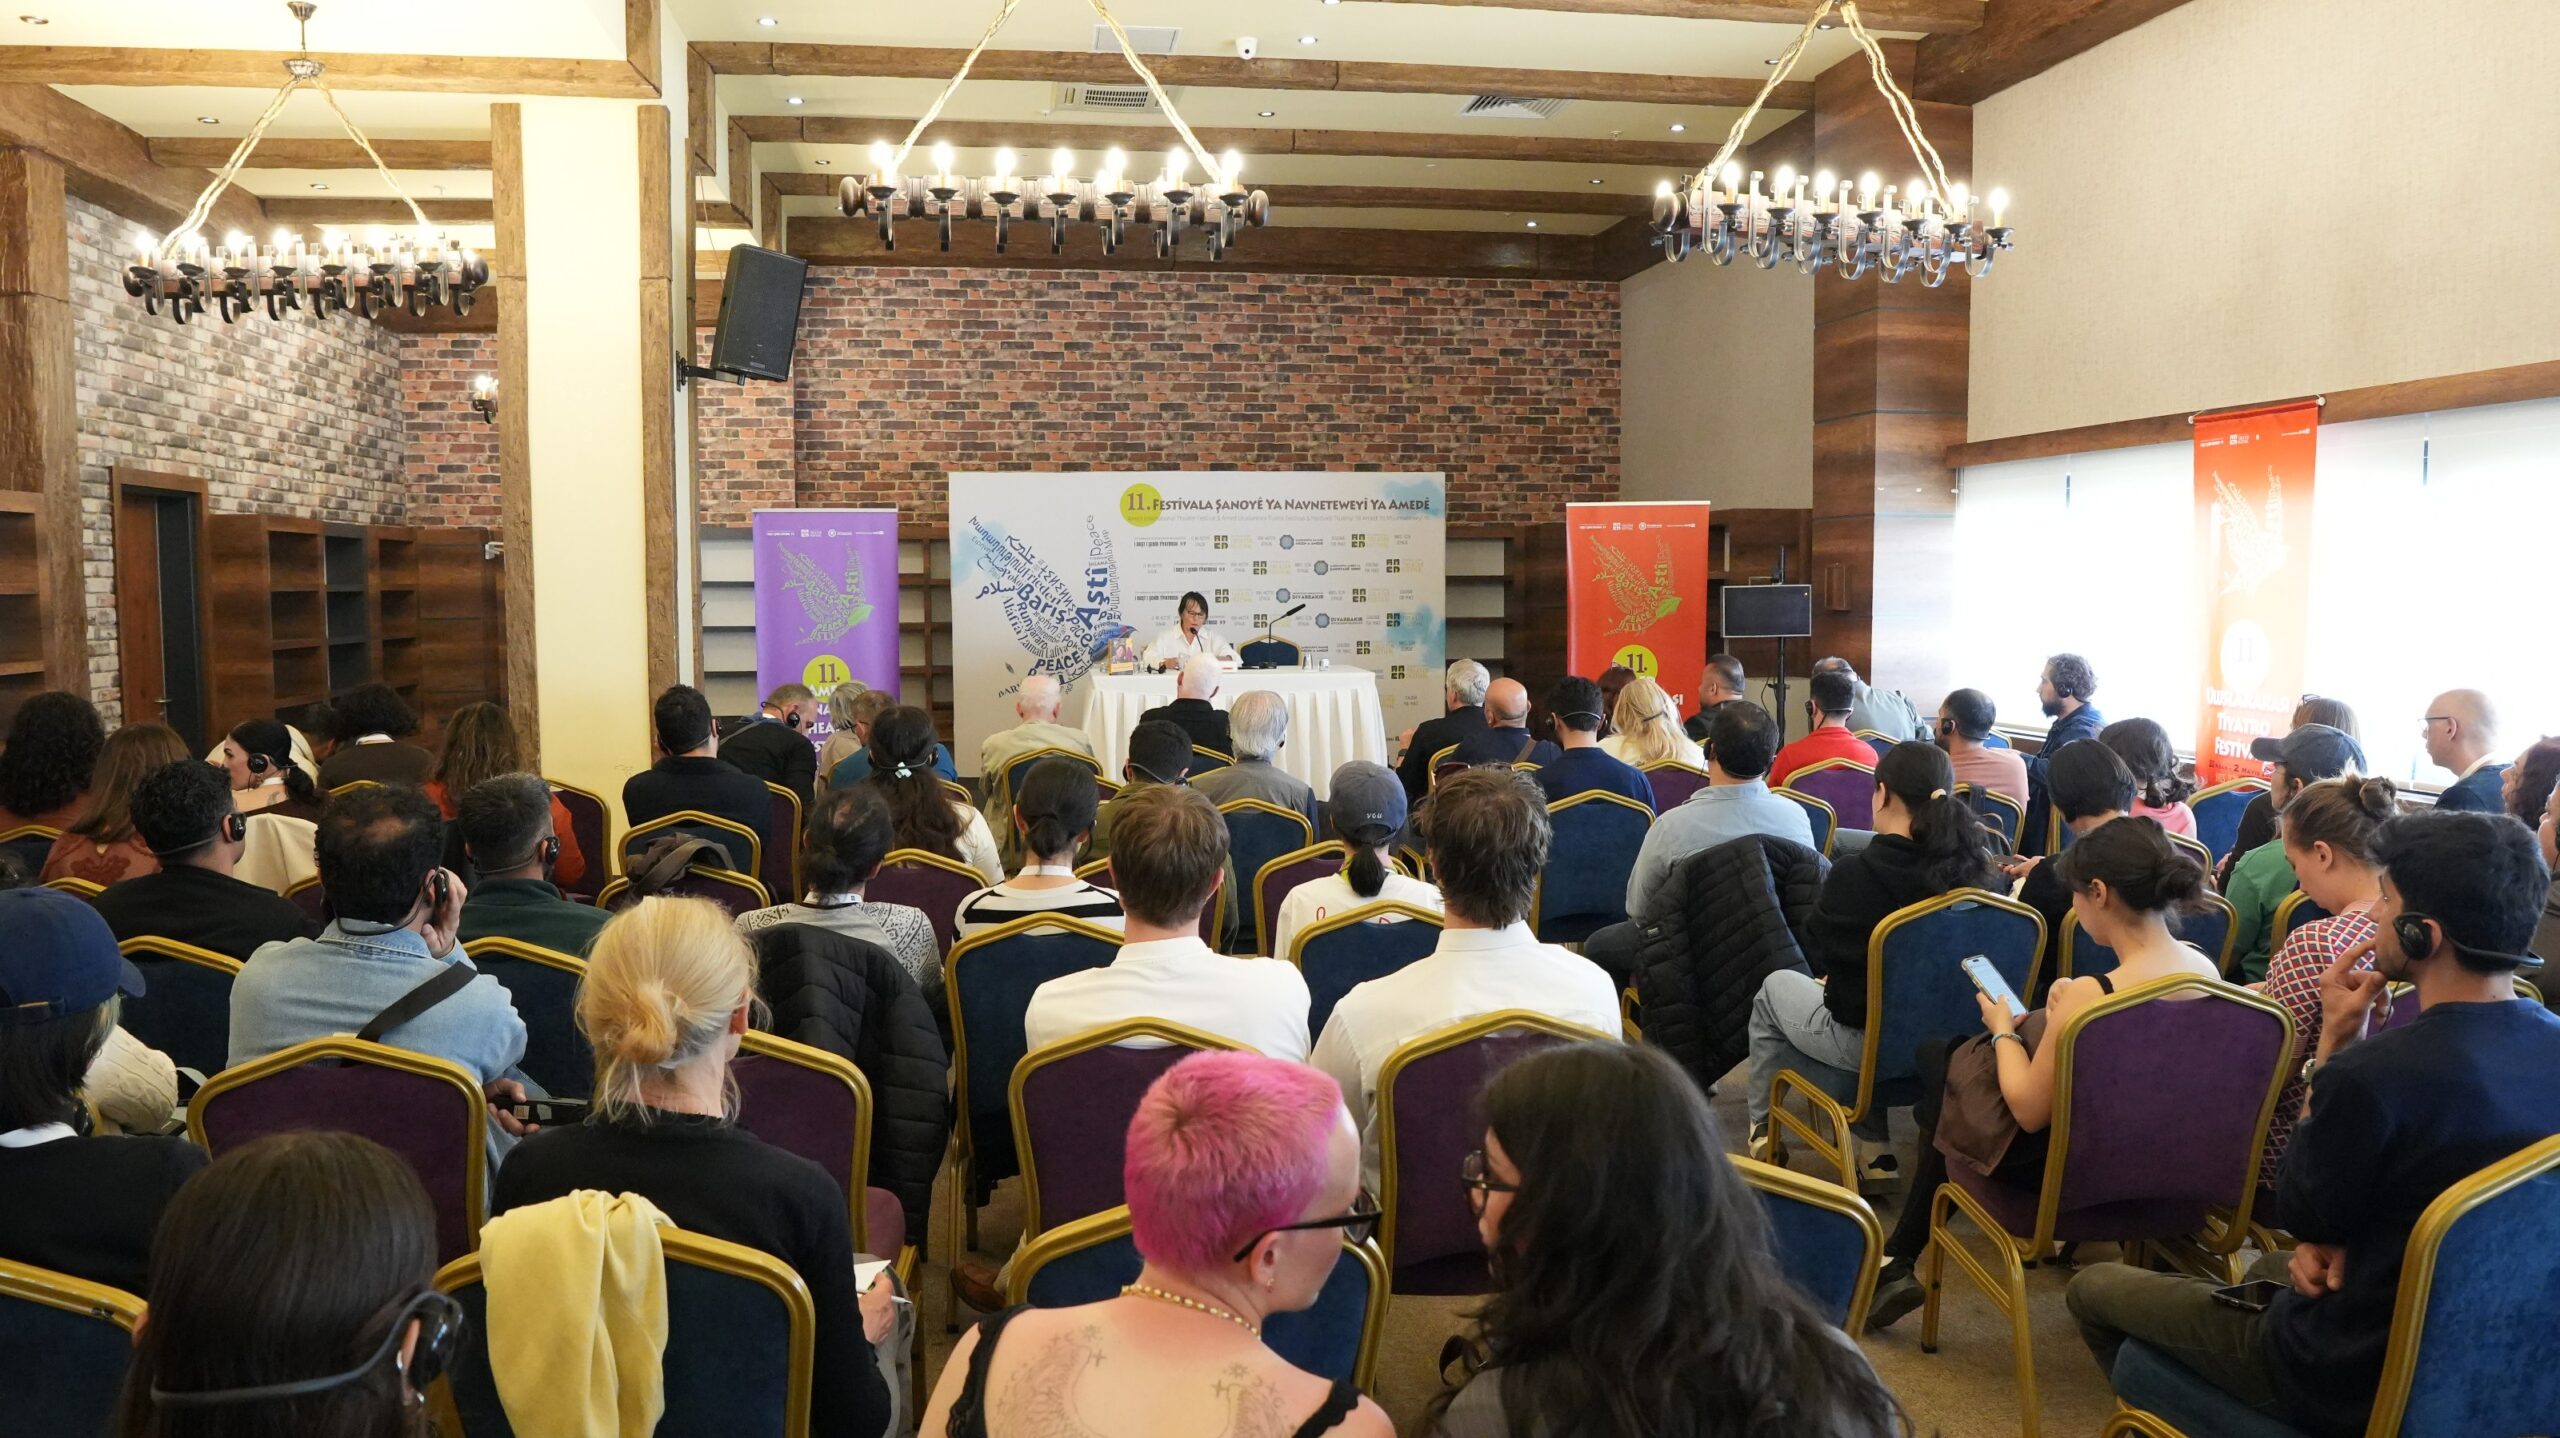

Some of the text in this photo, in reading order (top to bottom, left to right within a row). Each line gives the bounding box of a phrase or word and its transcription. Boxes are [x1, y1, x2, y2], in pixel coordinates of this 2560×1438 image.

[1127, 493, 1150, 511] 11.
[1266, 499, 1282, 510] YA
[1371, 499, 1386, 510] YA
[1035, 650, 1083, 671] PEACE
[818, 663, 840, 683] 11.
